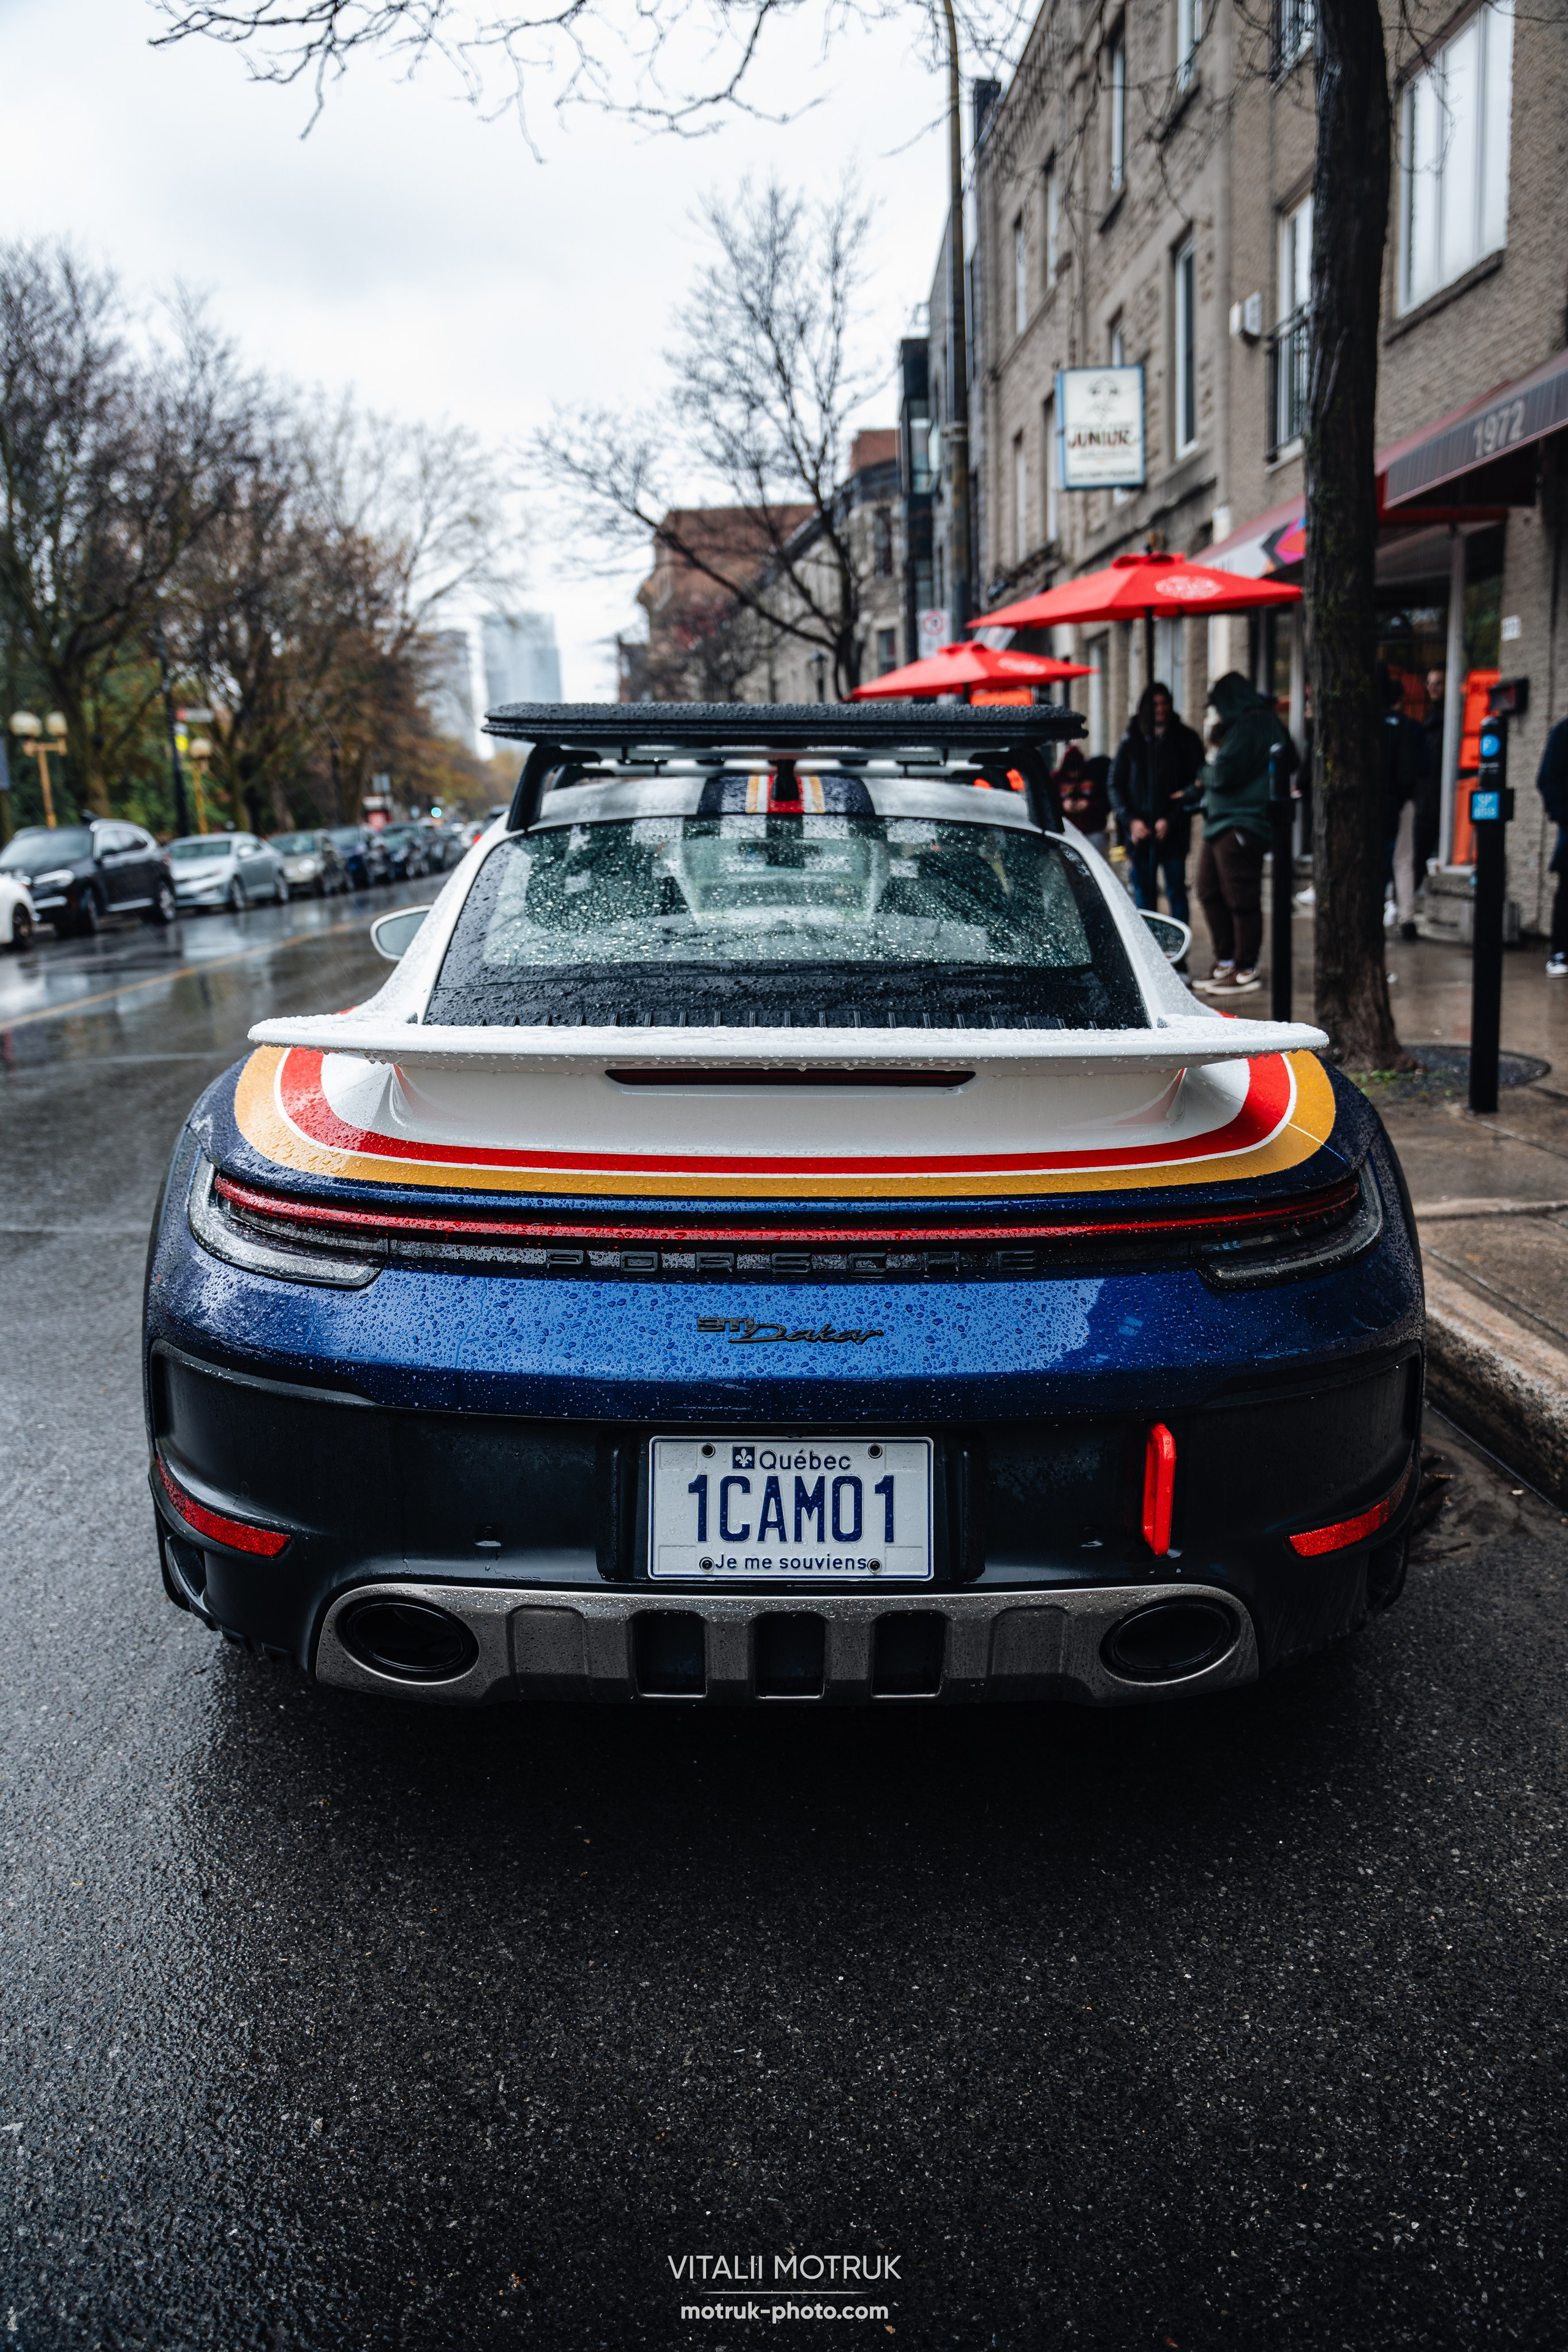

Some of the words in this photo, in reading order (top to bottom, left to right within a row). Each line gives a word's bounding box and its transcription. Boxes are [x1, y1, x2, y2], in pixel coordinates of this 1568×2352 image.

[1472, 399, 1525, 459] 1972
[545, 1249, 1036, 1276] PORSCHE
[728, 1324, 884, 1346] Dakar
[759, 1449, 851, 1470] Québec
[715, 1554, 737, 1570] Je
[745, 1558, 772, 1570] me
[780, 1554, 867, 1570] souviens
